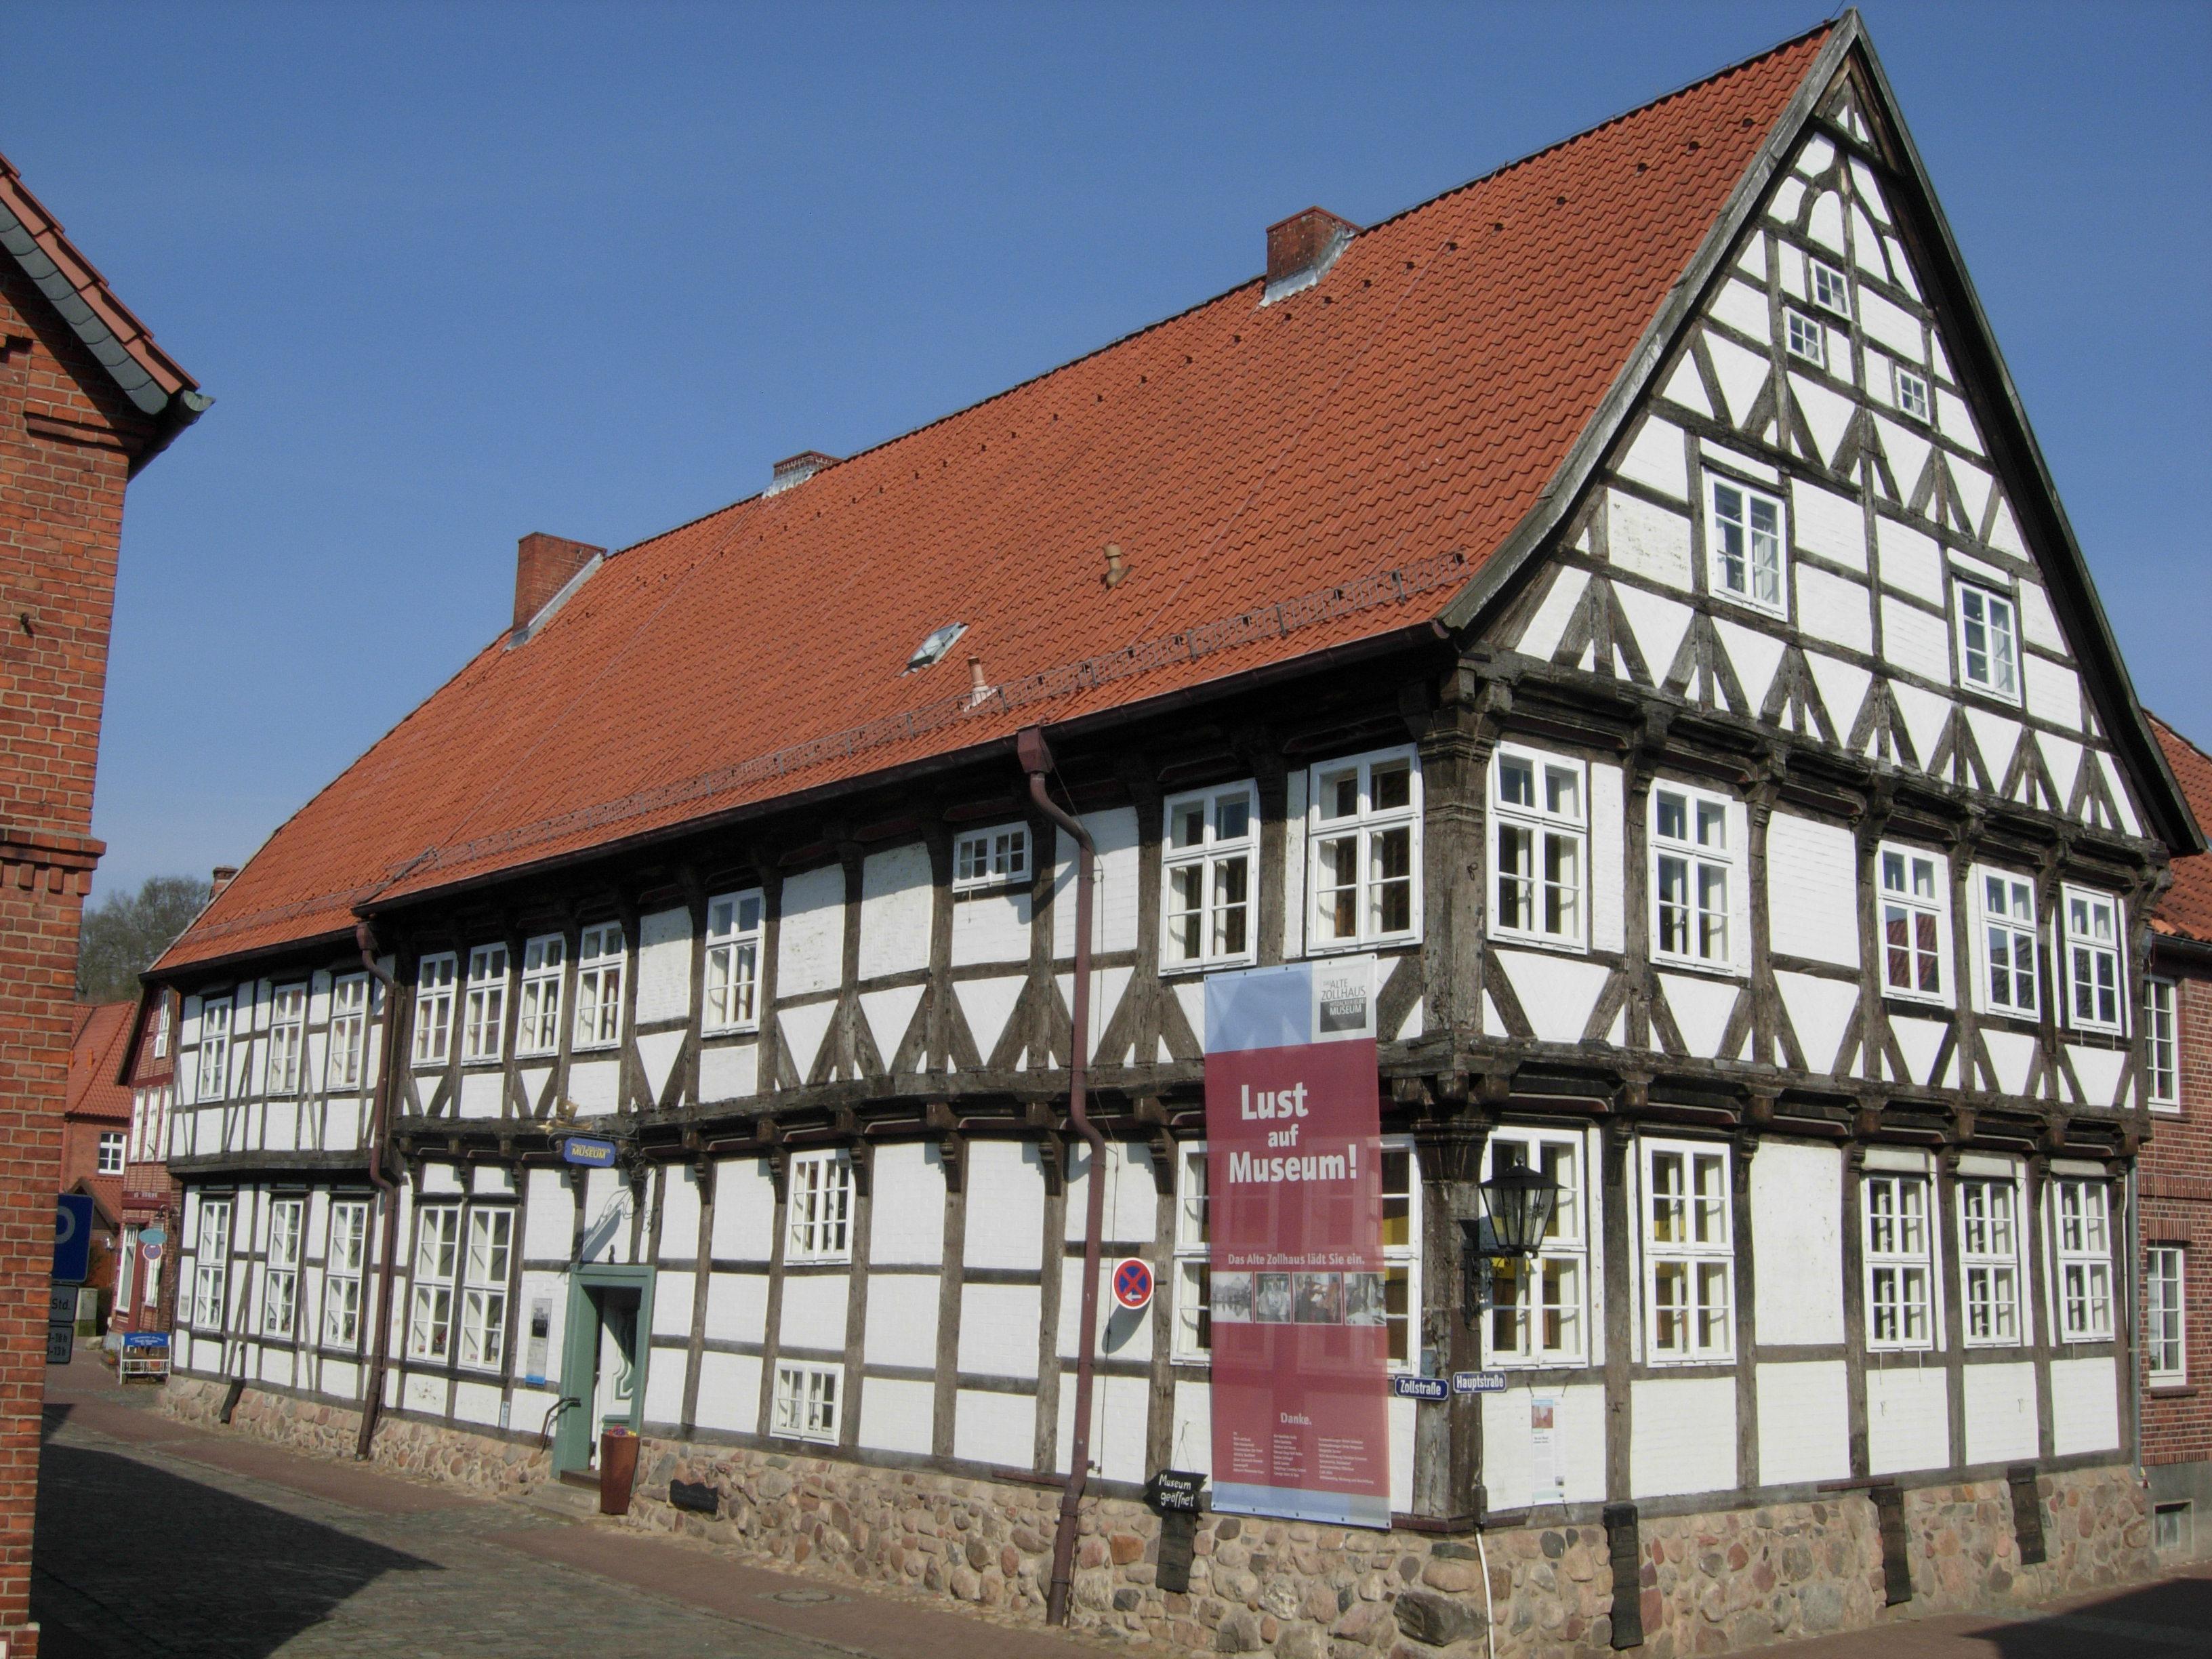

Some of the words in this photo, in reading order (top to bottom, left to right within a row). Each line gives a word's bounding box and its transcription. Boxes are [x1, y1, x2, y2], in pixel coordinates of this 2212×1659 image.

[1330, 979, 1347, 989] ALTE
[1322, 986, 1366, 1000] ZOLLHAUS
[1330, 1004, 1361, 1016] MUSEUM
[1241, 1082, 1309, 1120] Lust
[1268, 1124, 1299, 1147] auf
[571, 1147, 606, 1160] MUSEUM
[1229, 1144, 1356, 1183] Museum!
[1228, 1254, 1245, 1265] Das
[1247, 1253, 1265, 1265] Alte
[1267, 1253, 1305, 1265] Zollhaus
[1308, 1252, 1326, 1265] lädt
[1329, 1252, 1345, 1265] Sie
[1347, 1252, 1365, 1265] ein.
[52, 1298, 70, 1310] Std.
[1400, 1380, 1441, 1395] Zollstraße
[1457, 1375, 1504, 1391] Hauptstraße
[1280, 1412, 1312, 1425] Danke.
[1159, 1474, 1191, 1490] Museum
[1160, 1491, 1194, 1508] geöffnet
